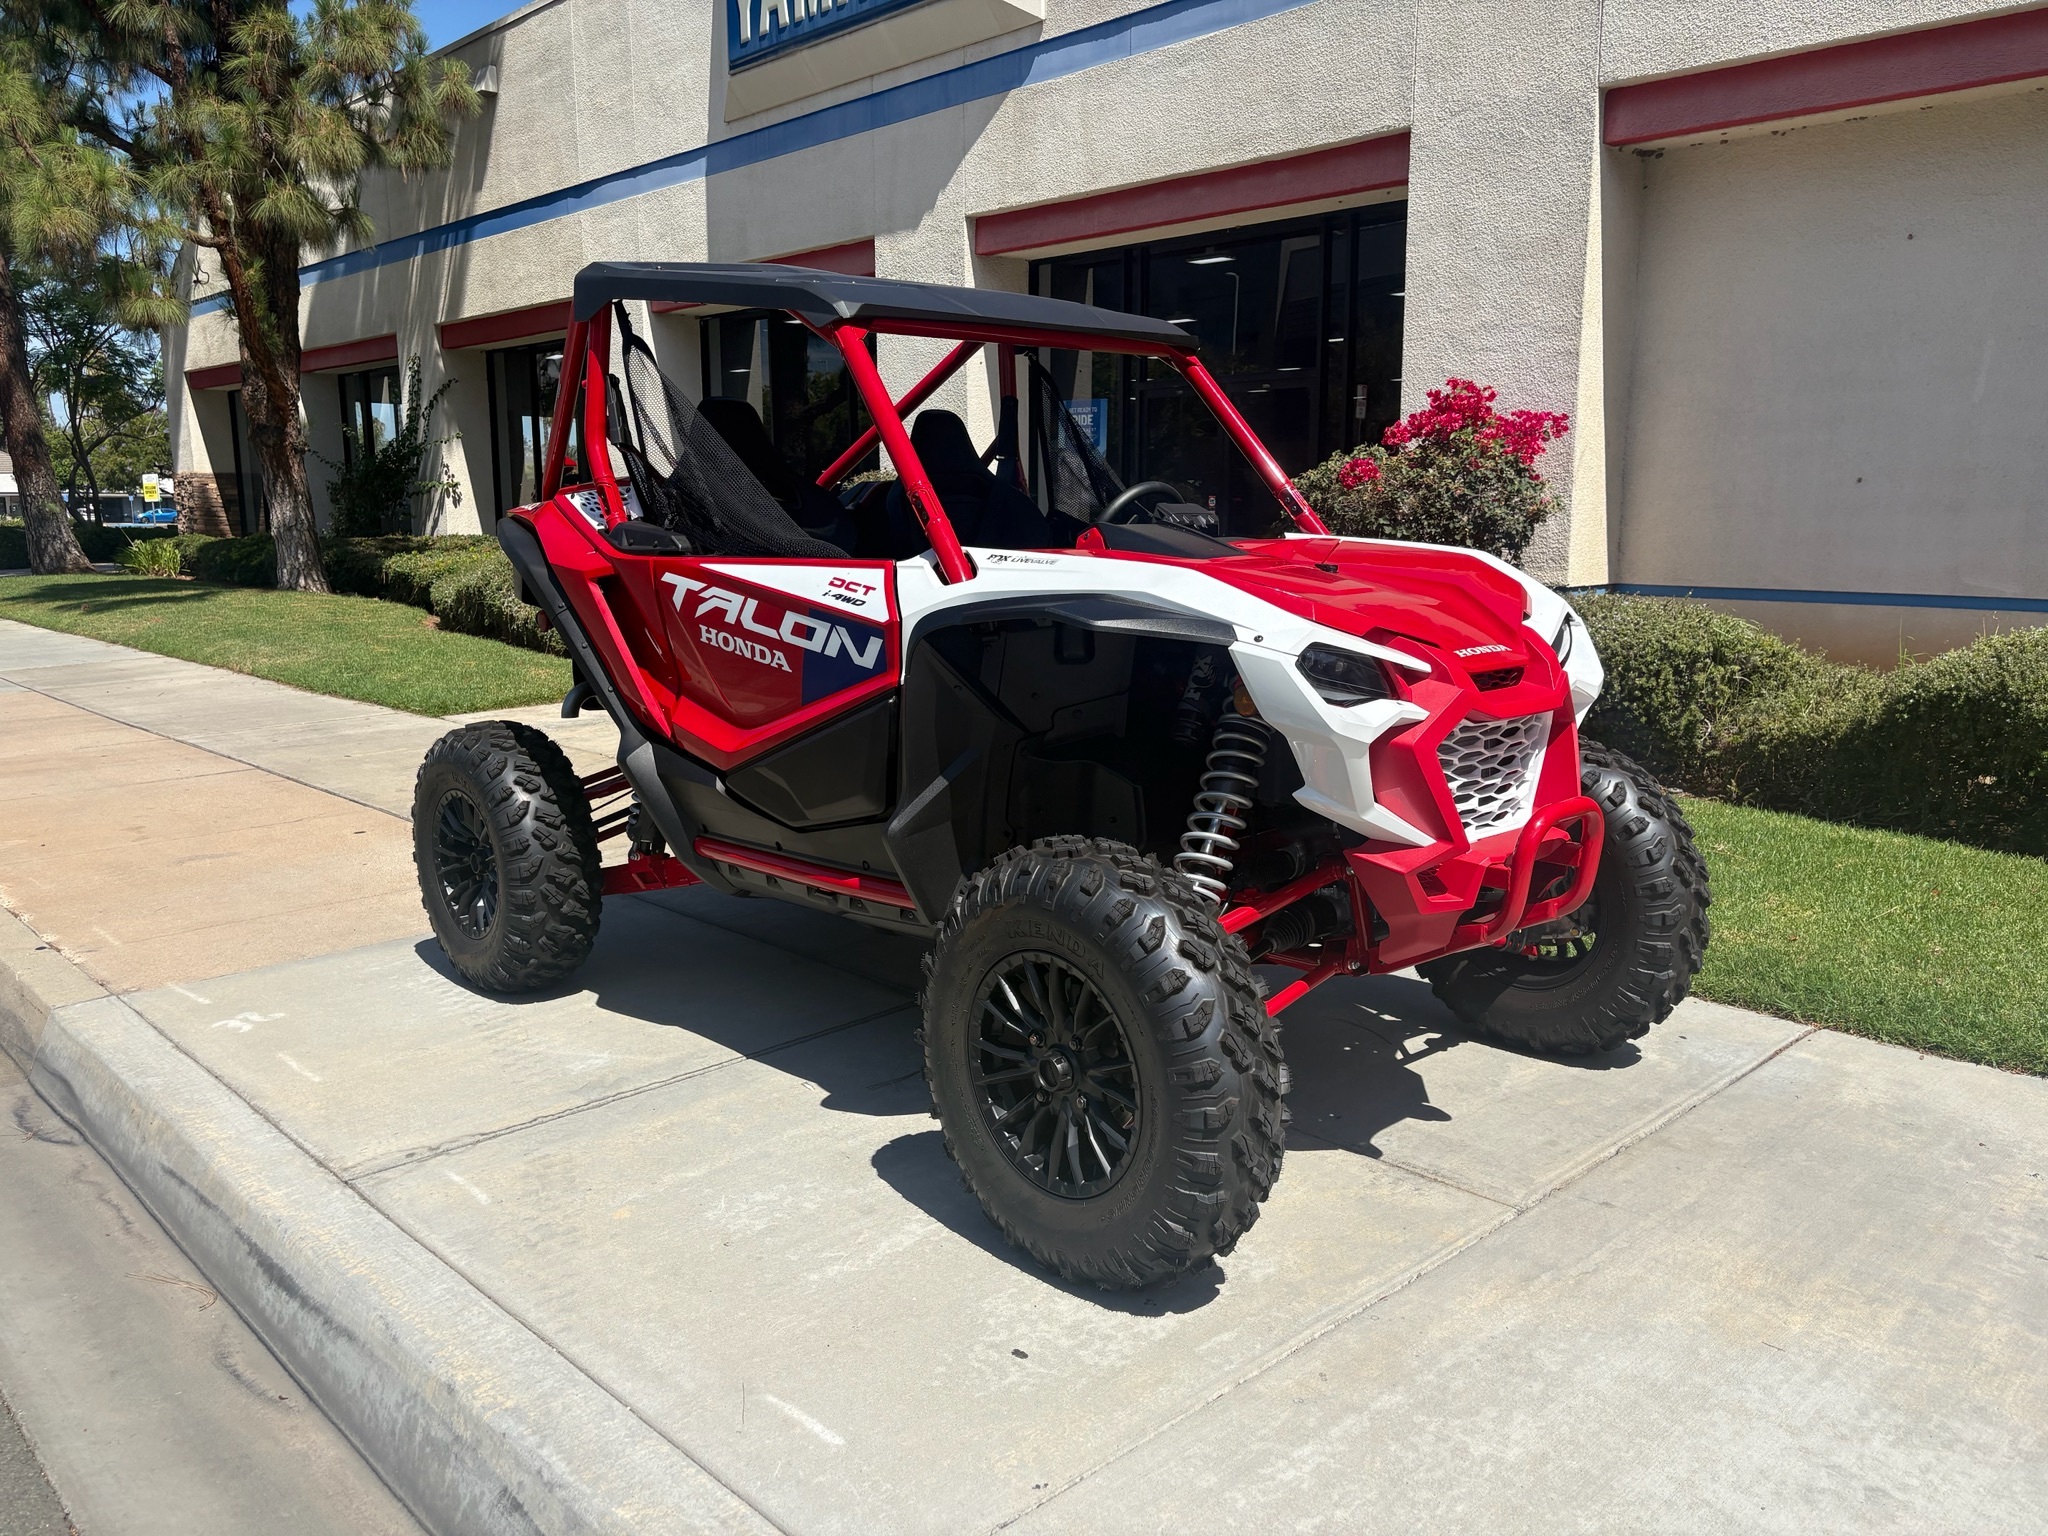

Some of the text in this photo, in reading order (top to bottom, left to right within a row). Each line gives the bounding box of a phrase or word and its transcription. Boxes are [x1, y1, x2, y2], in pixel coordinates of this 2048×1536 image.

[828, 577, 877, 596] DCT
[661, 572, 883, 669] TALON
[699, 624, 792, 673] HONDA
[1453, 644, 1513, 658] HONDA
[1183, 655, 1216, 701] FOX
[1006, 918, 1105, 980] KENDA
